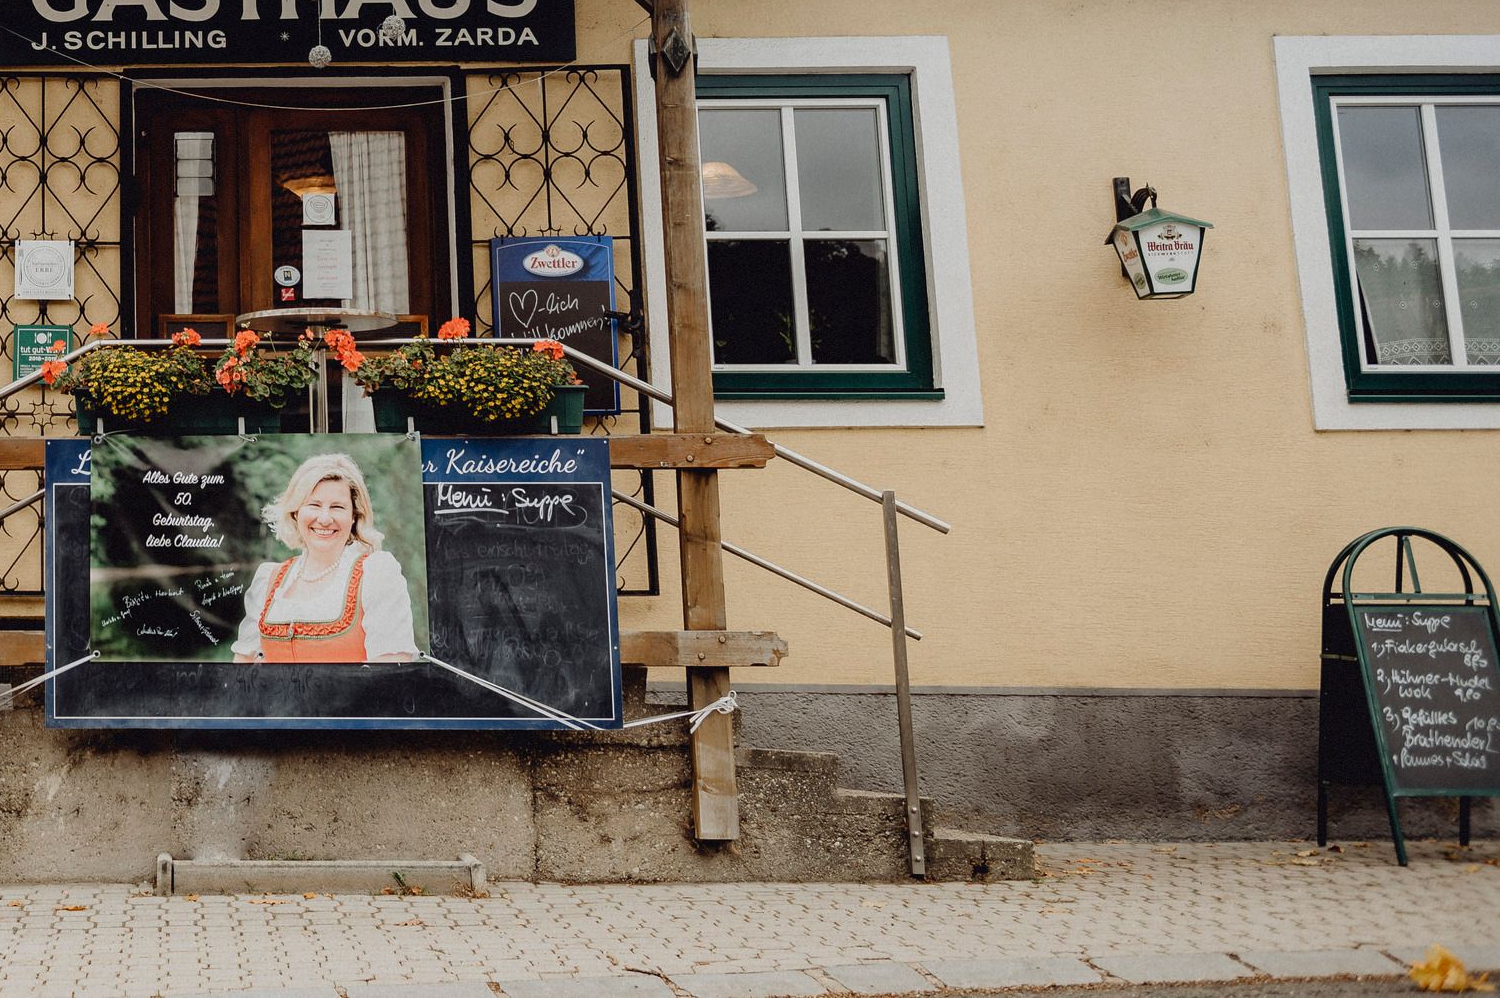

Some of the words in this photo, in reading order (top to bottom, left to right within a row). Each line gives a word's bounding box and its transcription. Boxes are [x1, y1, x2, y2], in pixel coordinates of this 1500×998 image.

[31, 32, 57, 50] J.
[63, 30, 227, 50] SCHILLING
[435, 26, 540, 46] ZARDA
[1146, 241, 1173, 252] Weitra
[530, 257, 578, 269] Zwettler
[20, 345, 31, 353] tut
[142, 470, 170, 484] Alles
[172, 471, 199, 484] Gute
[200, 474, 225, 489] zum
[174, 492, 192, 505] 50.
[511, 487, 576, 522] Suppe
[145, 534, 172, 547] liebe
[174, 534, 225, 548] Claudia!
[1411, 612, 1451, 634] Suppe
